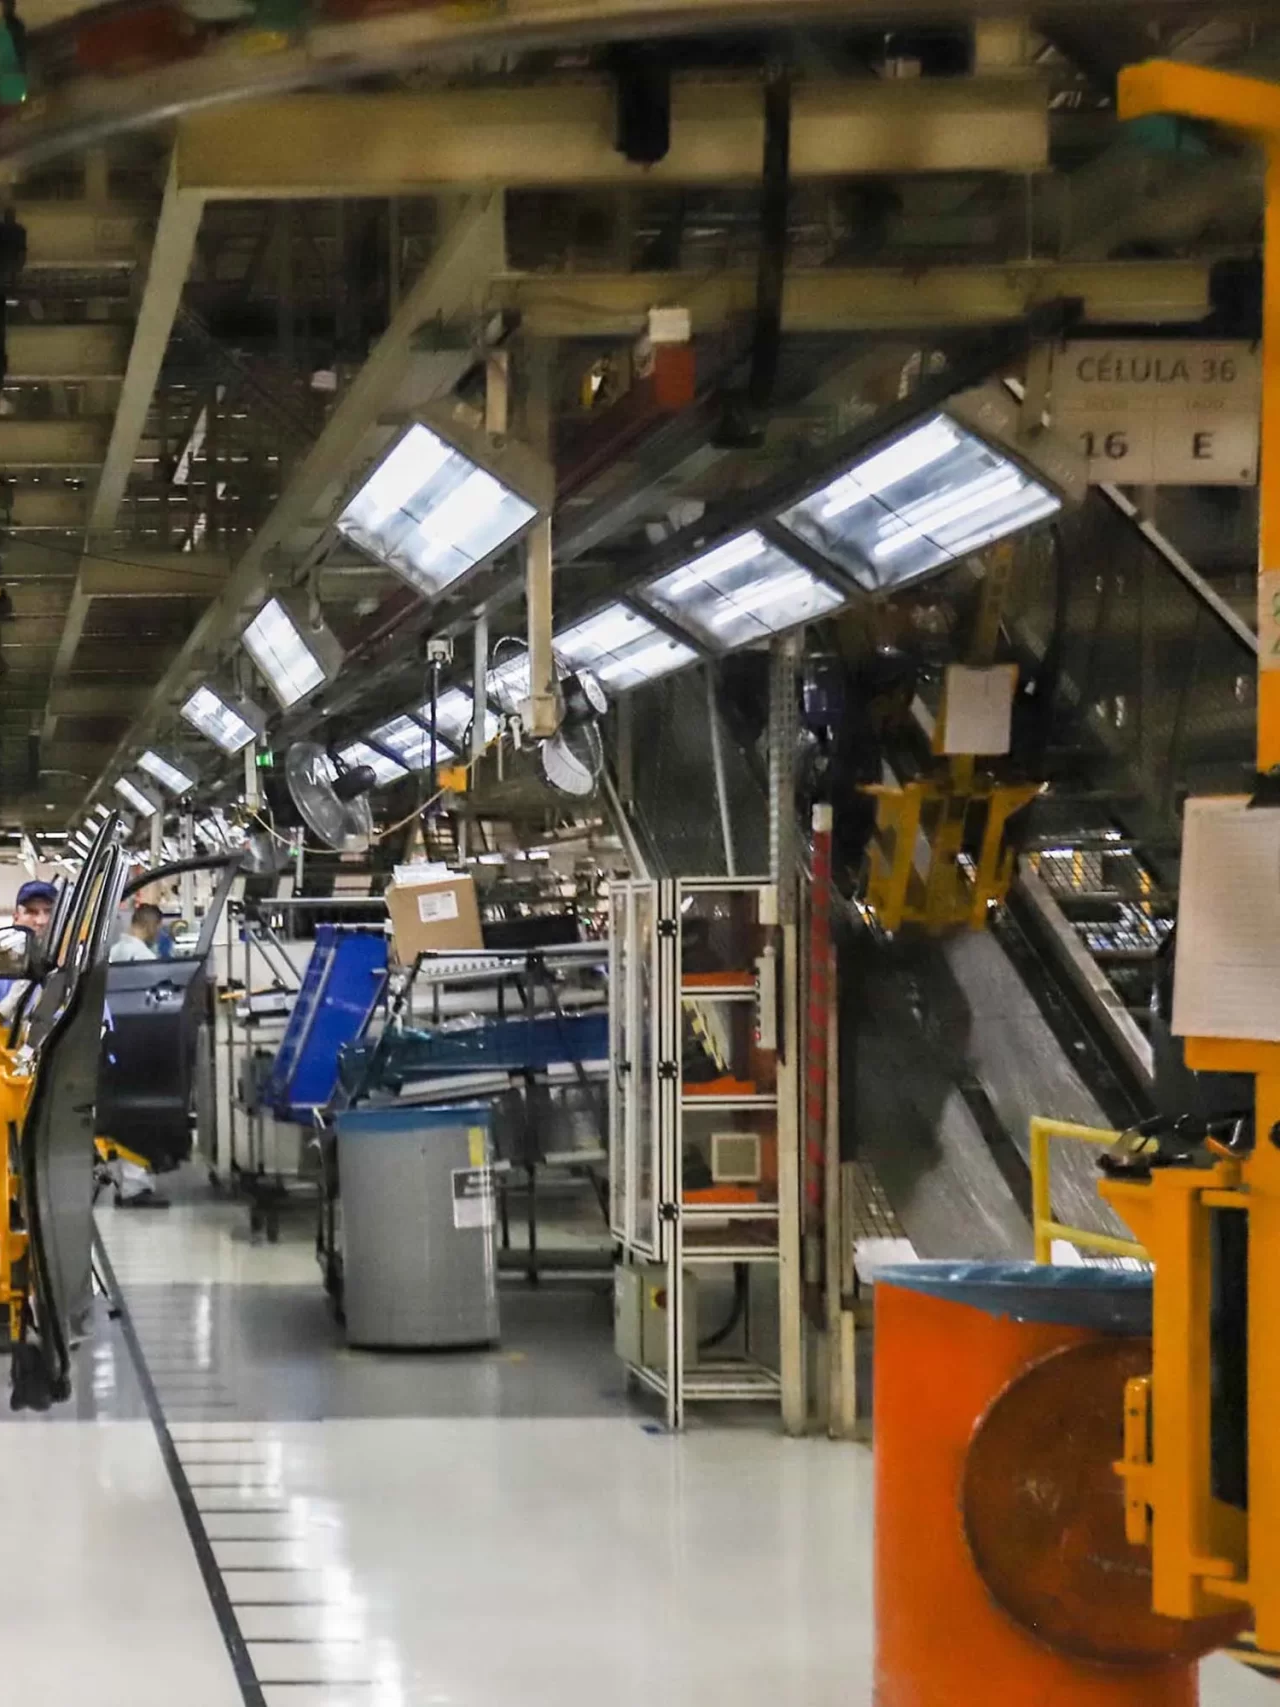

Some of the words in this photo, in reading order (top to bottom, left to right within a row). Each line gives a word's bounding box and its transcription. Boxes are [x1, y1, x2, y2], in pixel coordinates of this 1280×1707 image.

[1076, 350, 1190, 384] CÉLULA
[1201, 358, 1238, 384] 36
[1079, 430, 1129, 460] 16
[1192, 431, 1215, 459] E
